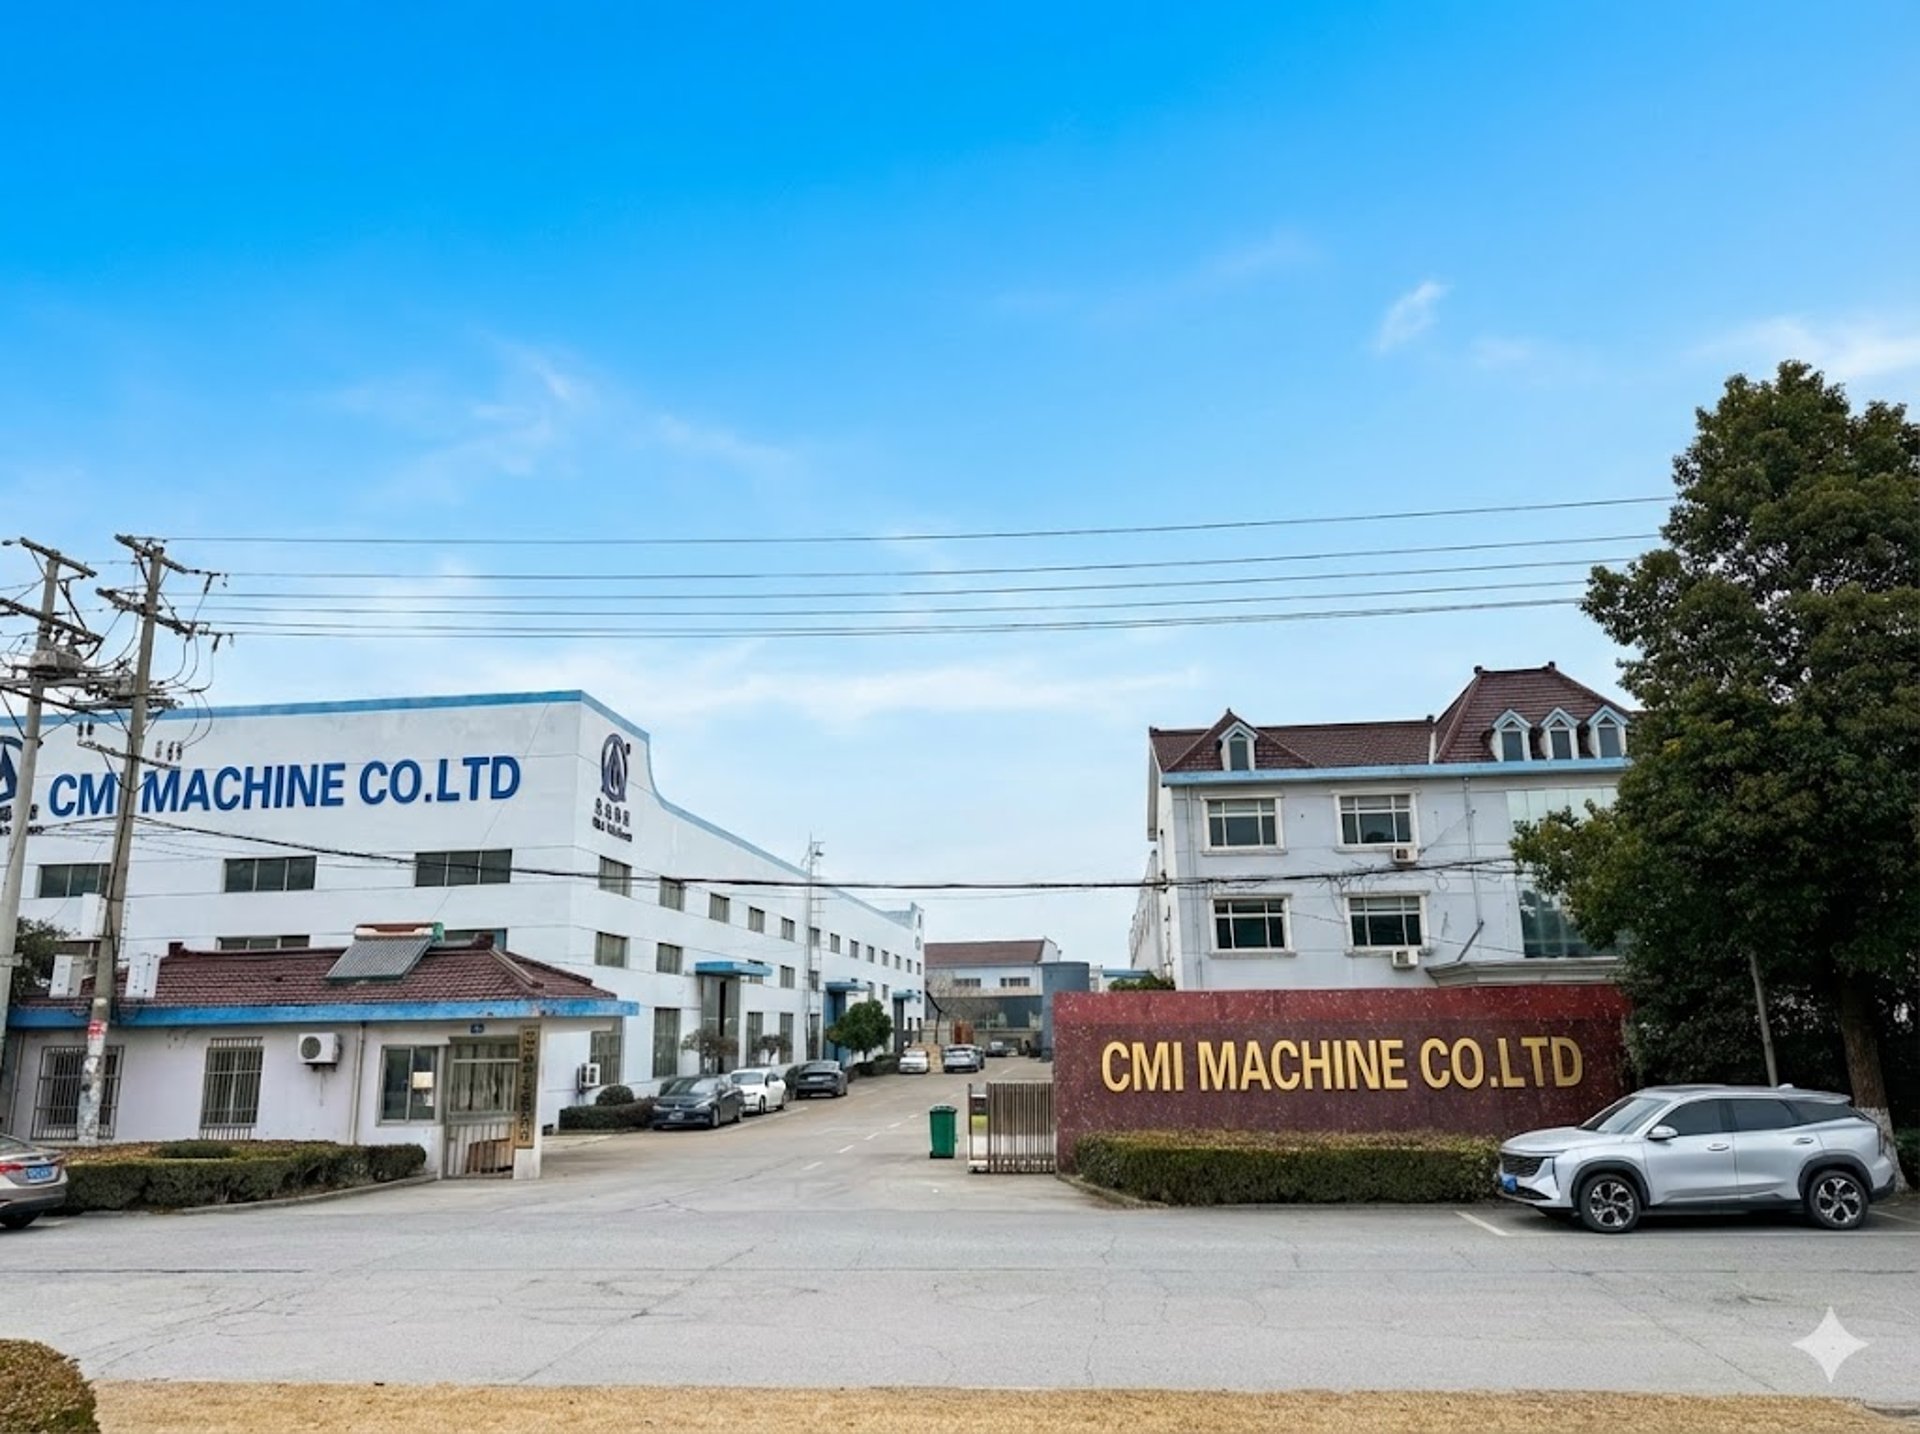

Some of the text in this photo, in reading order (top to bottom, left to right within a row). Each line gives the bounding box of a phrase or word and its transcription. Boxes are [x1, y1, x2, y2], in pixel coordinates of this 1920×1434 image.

[50, 755, 521, 817] CM MACHINE CO.LTD
[1102, 1036, 1583, 1092] CMI MACHINE CO.LTD
